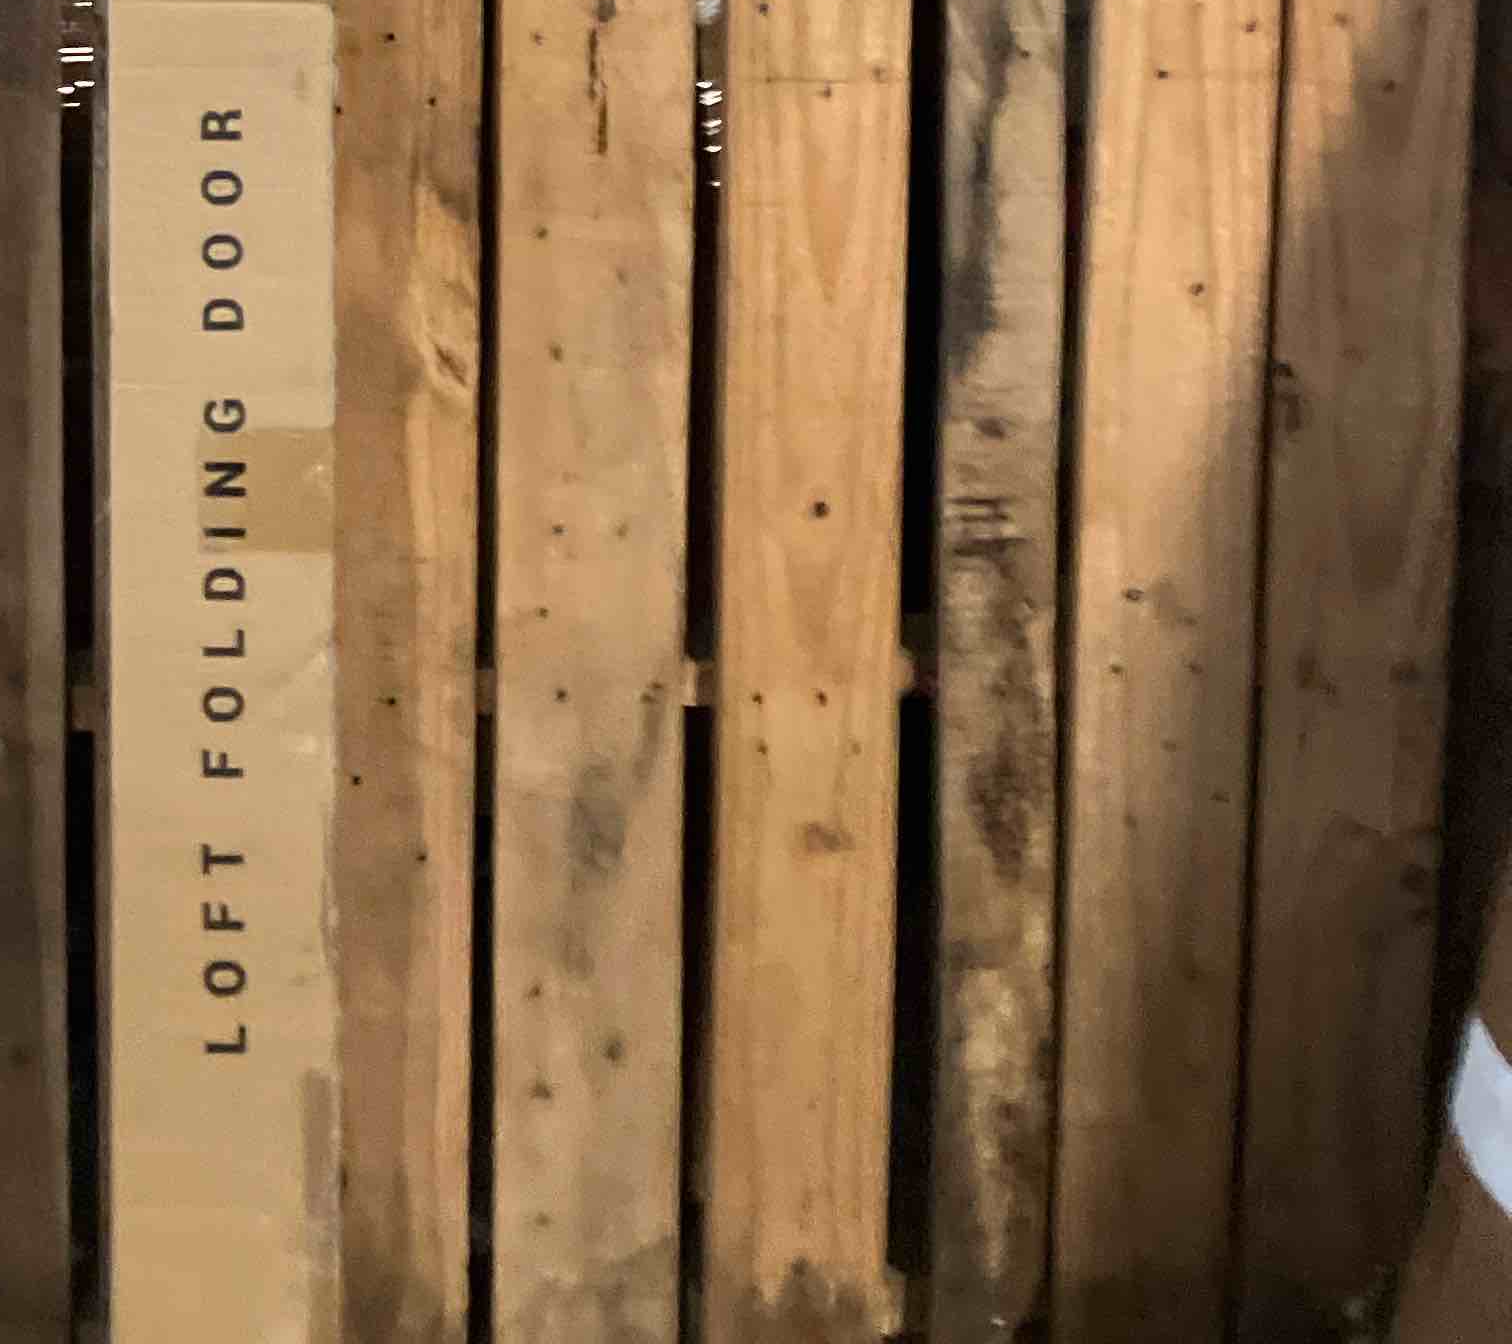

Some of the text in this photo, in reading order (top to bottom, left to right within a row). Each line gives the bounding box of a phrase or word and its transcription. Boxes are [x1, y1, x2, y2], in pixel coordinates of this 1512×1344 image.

[200, 109, 248, 1054] LOFT FOLDING DOOR
